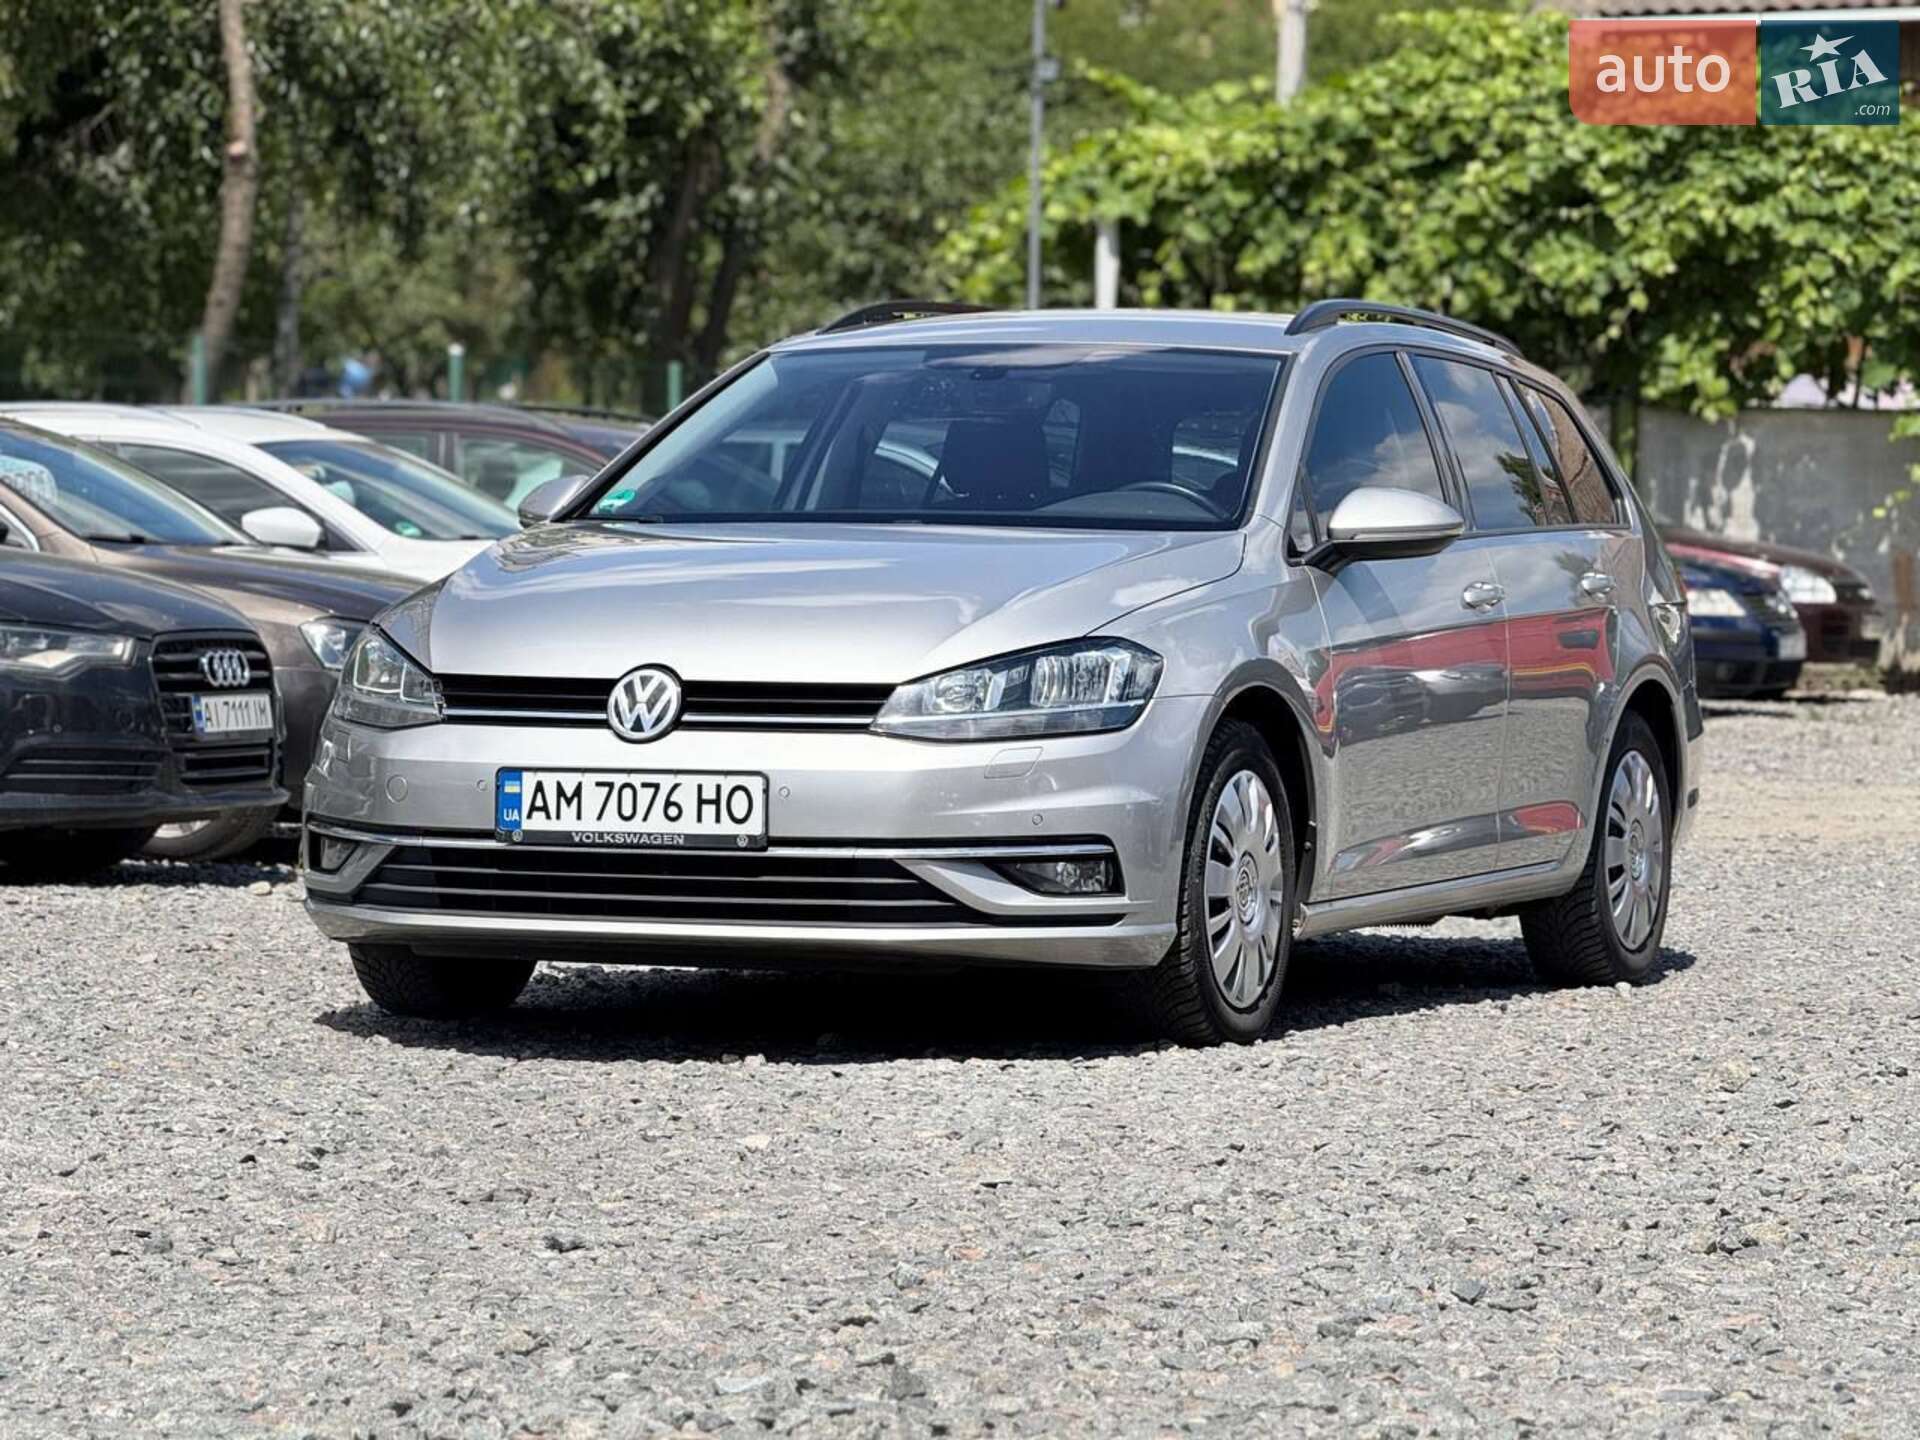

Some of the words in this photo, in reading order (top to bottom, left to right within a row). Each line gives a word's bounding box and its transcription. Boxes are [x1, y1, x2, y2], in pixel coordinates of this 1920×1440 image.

[223, 701, 252, 728] 7111
[526, 780, 583, 821] AM
[595, 781, 683, 823] 7076
[696, 783, 754, 825] HO
[503, 808, 520, 822] UA
[571, 831, 685, 846] VOLKSWAGEN
